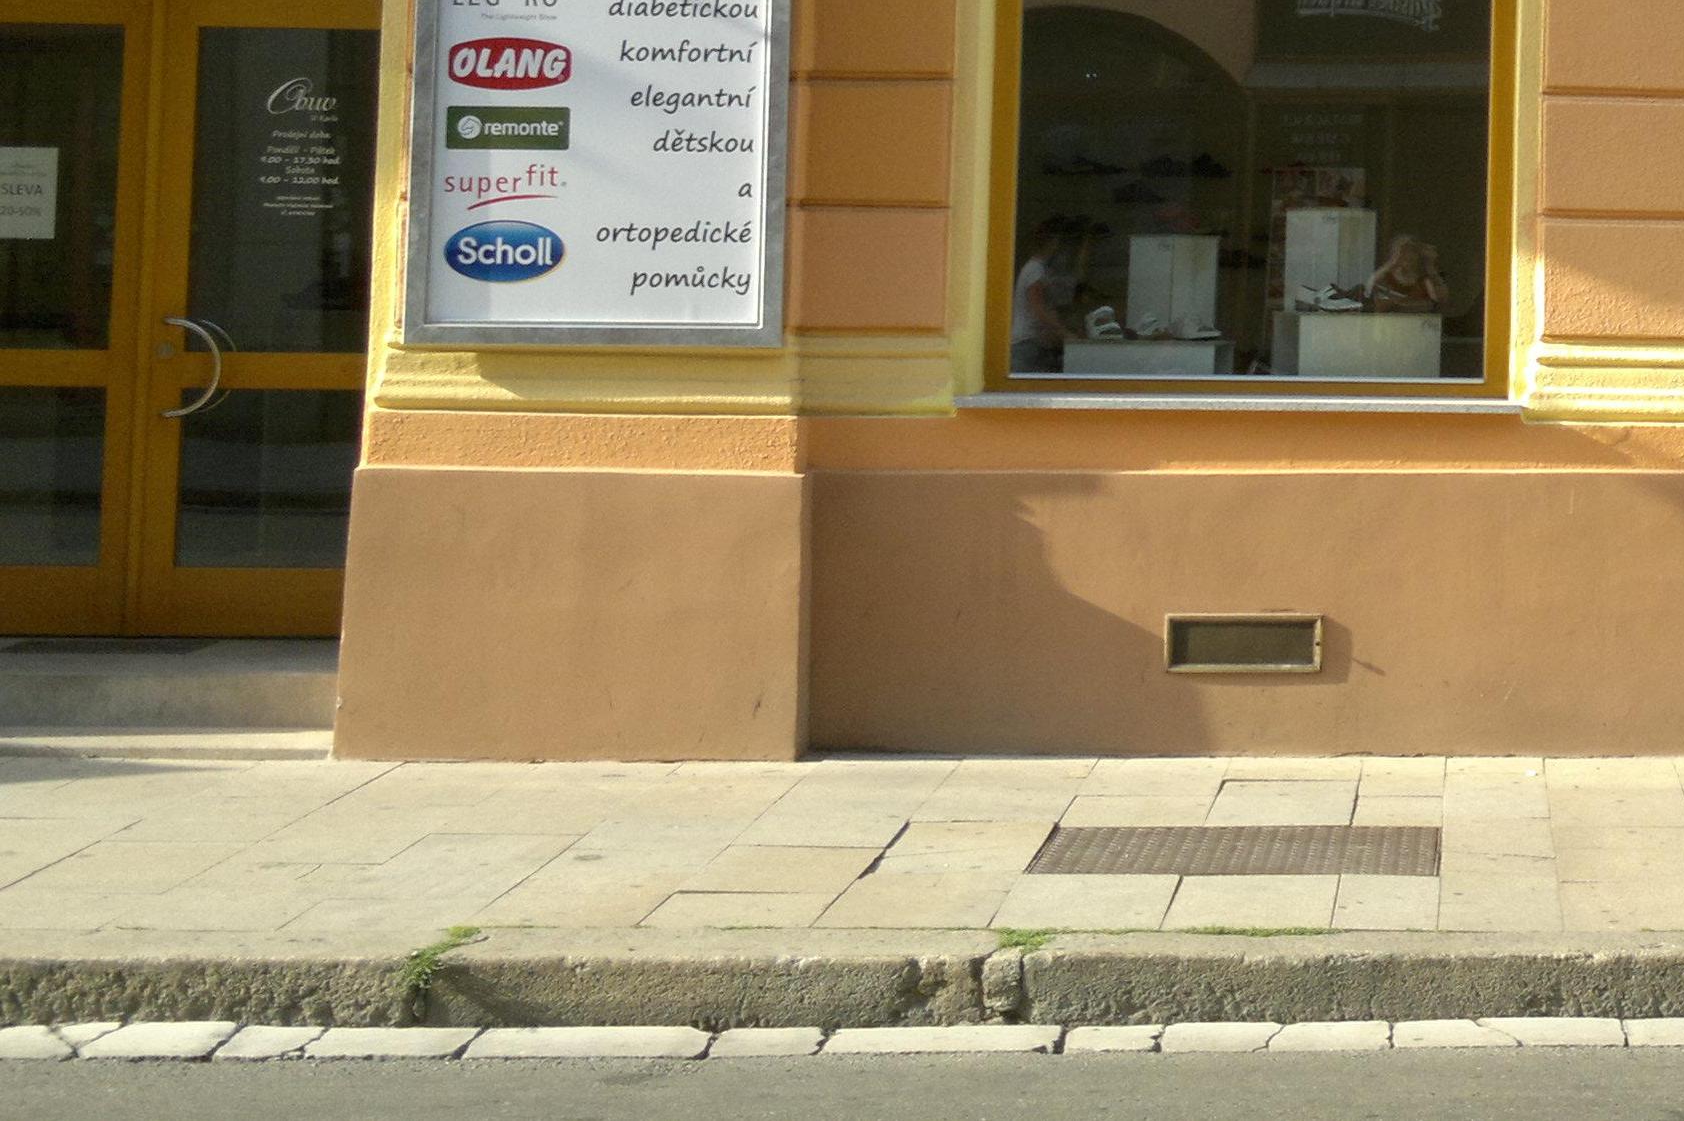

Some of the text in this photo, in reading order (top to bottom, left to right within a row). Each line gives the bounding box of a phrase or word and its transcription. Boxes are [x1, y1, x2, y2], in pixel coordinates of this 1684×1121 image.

[453, 48, 569, 79] OLANG
[619, 40, 758, 65] komfortní
[630, 86, 757, 115] elegantní
[484, 119, 559, 137] remonte
[653, 128, 755, 154] dětskou
[738, 181, 753, 199] a
[596, 220, 753, 250] ortopedické
[457, 237, 554, 266] Scholl
[630, 266, 752, 295] pomůcky
